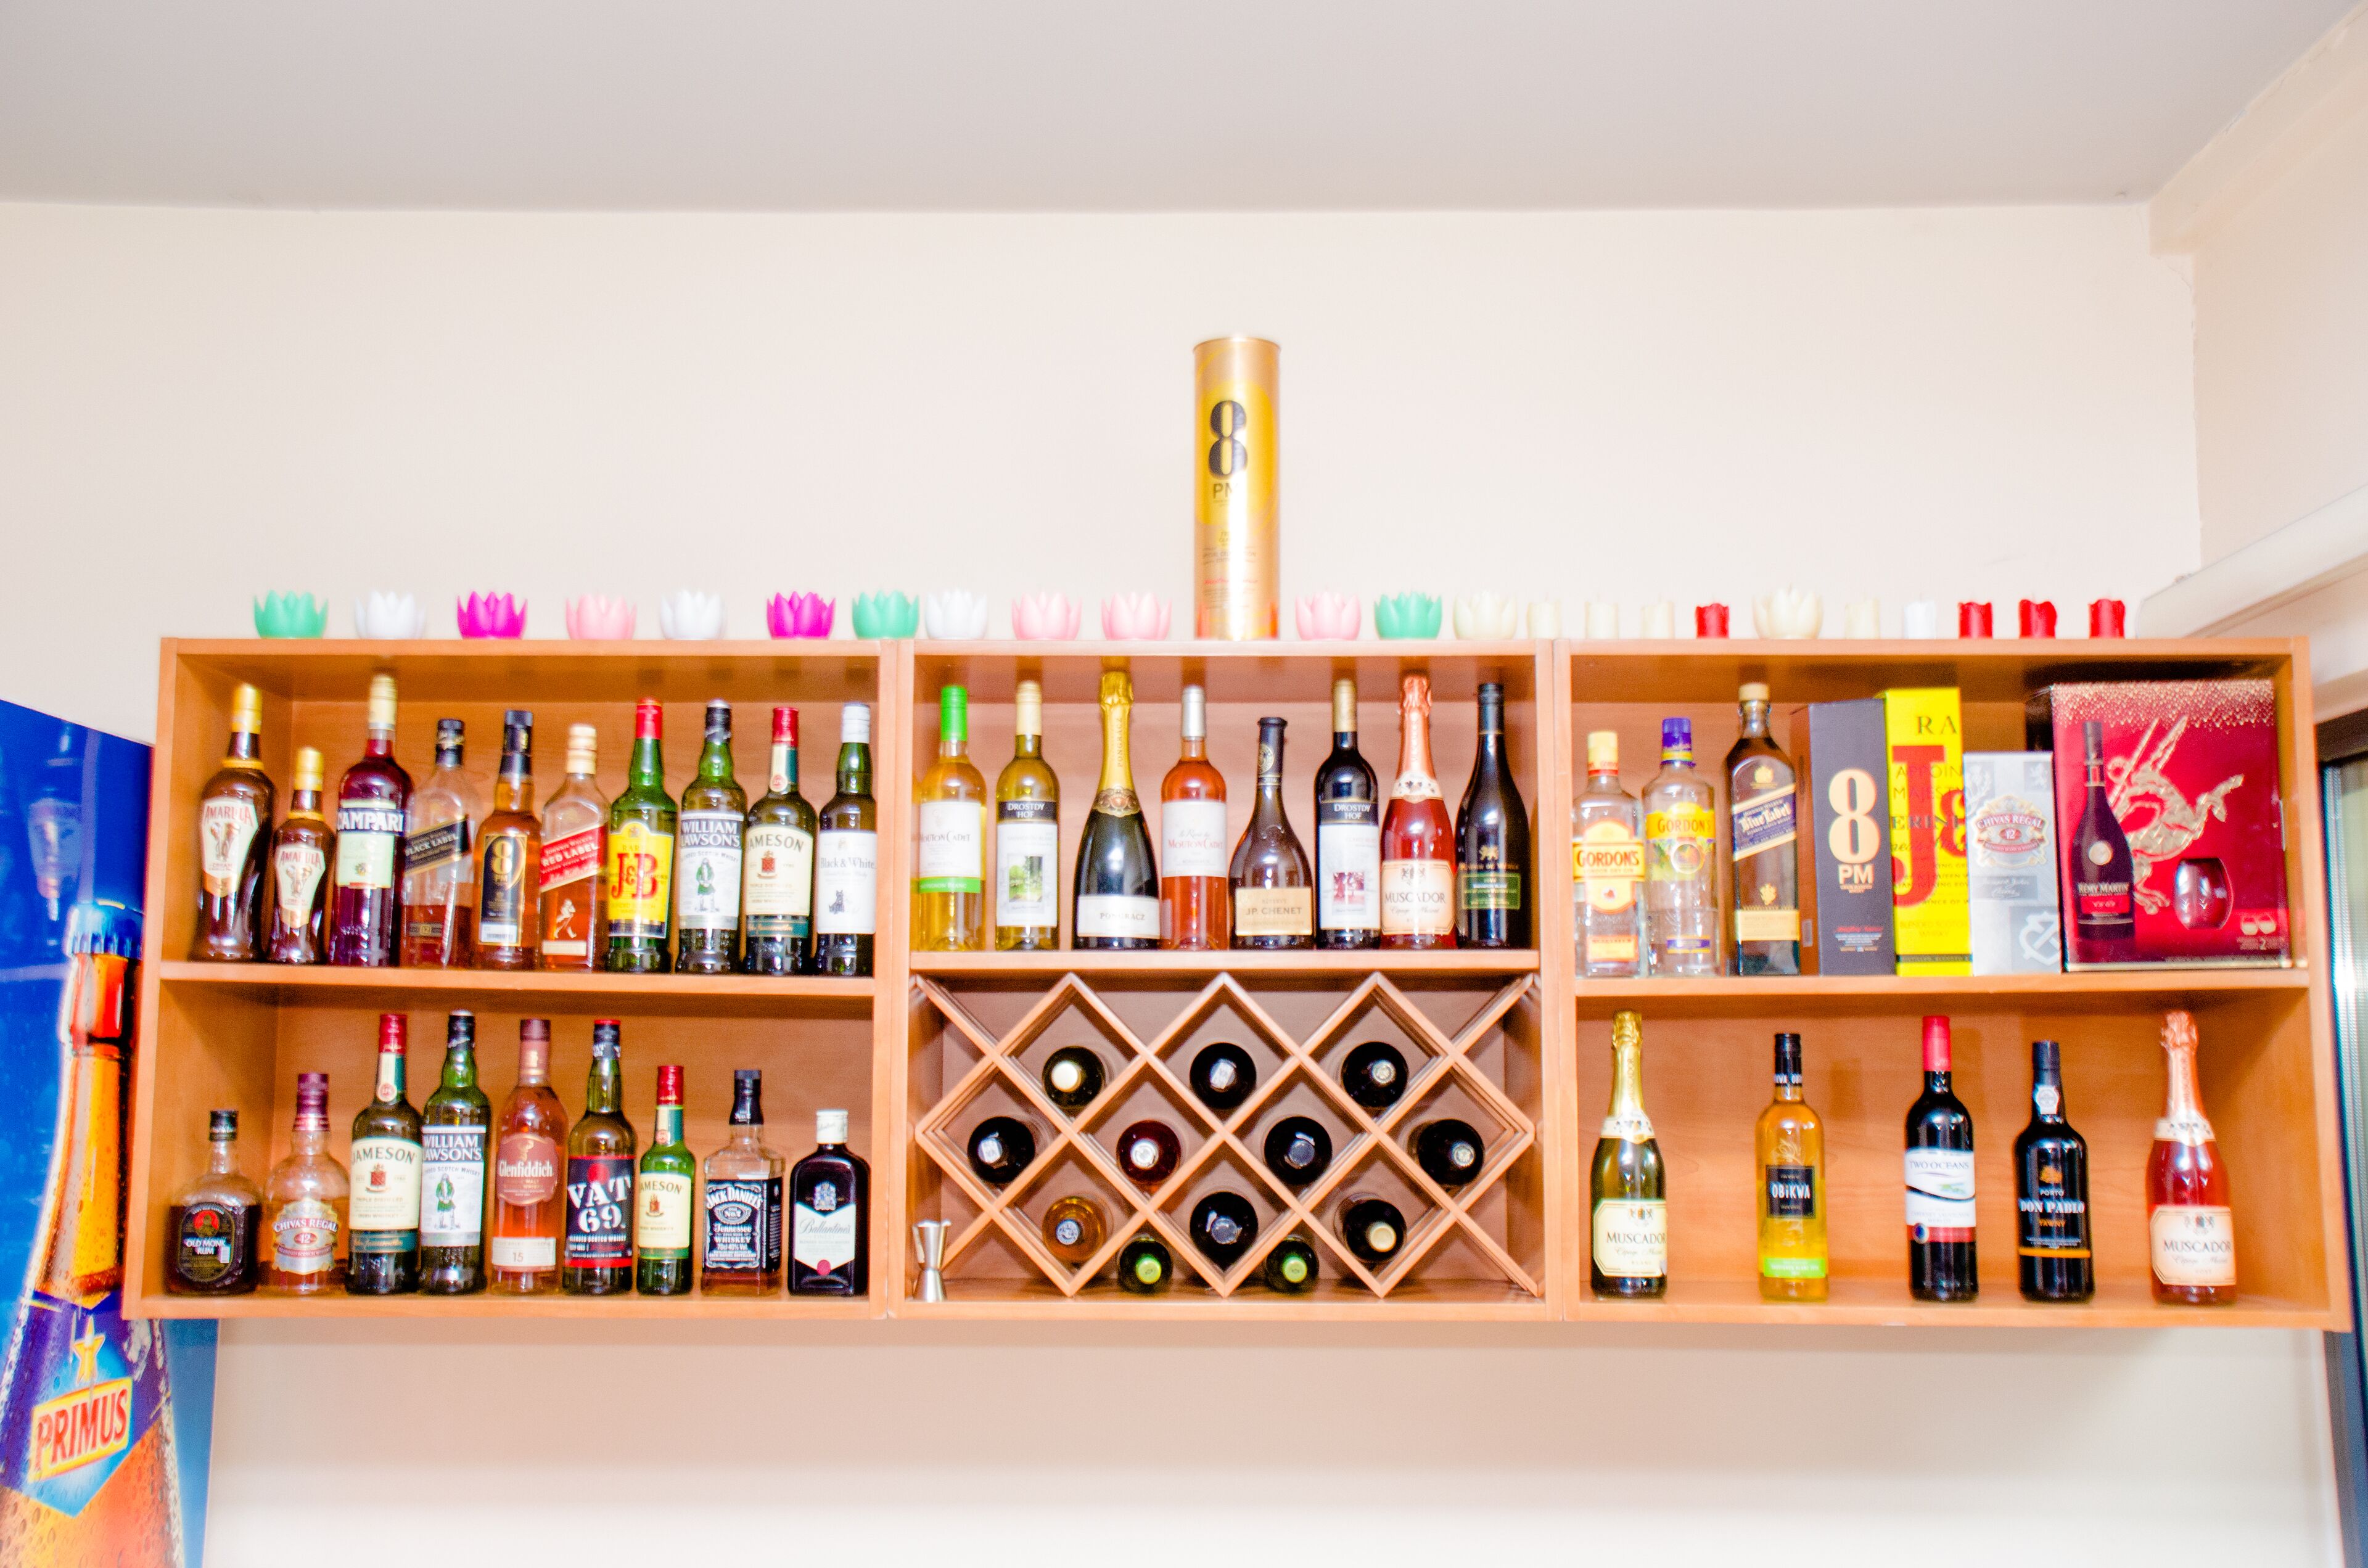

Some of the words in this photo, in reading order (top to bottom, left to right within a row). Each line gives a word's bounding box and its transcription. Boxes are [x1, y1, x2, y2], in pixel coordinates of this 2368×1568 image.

[1208, 400, 1248, 479] 8
[1007, 803, 1045, 811] DROSTDY
[1334, 804, 1371, 812] DROSTDY
[1738, 813, 1766, 832] Blue
[1762, 802, 1792, 824] Label
[1829, 770, 1880, 863] 8
[1976, 814, 2010, 829] CHIVAS
[2012, 814, 2044, 829] REGAL
[682, 821, 737, 834] WILLIAM
[1657, 818, 1712, 833] GORDON'S
[2005, 829, 2016, 839] 12
[749, 834, 804, 852] AMESON
[491, 840, 513, 874] 8
[542, 855, 563, 867] RED
[564, 843, 598, 859] LABEL
[1577, 850, 1640, 868] GORDON'S
[611, 853, 659, 900] J&B
[1838, 864, 1875, 884] PM
[1261, 907, 1302, 915] CHENET
[423, 1134, 479, 1148] WILLIAM
[352, 1146, 416, 1165] JAMESON
[424, 1147, 482, 1162] AWSON'S
[499, 1159, 553, 1178] Glenfiddich
[1930, 1161, 1970, 1170] OCEANS
[567, 1175, 631, 1209] VAT
[640, 1180, 683, 1195] AMESON
[2040, 1188, 2065, 1196] PORTO
[706, 1189, 728, 1210] JACK
[726, 1186, 763, 1210] DANIEL'S
[2020, 1200, 2044, 1213] DON
[2046, 1201, 2086, 1213] PABLO
[274, 1218, 307, 1233] CHIVAS
[309, 1218, 338, 1233] REGAL
[713, 1222, 752, 1233] Tennessee
[799, 1218, 850, 1234] Ballantine's
[186, 1238, 202, 1247] OLD
[202, 1238, 226, 1247] MONK
[300, 1233, 311, 1244] 12
[713, 1236, 752, 1244] WHISKEY
[2163, 1239, 2231, 1253] MUSCADOR
[197, 1246, 215, 1255] RUM
[512, 1252, 524, 1263] 15
[35, 1388, 128, 1469] PRIMUS
